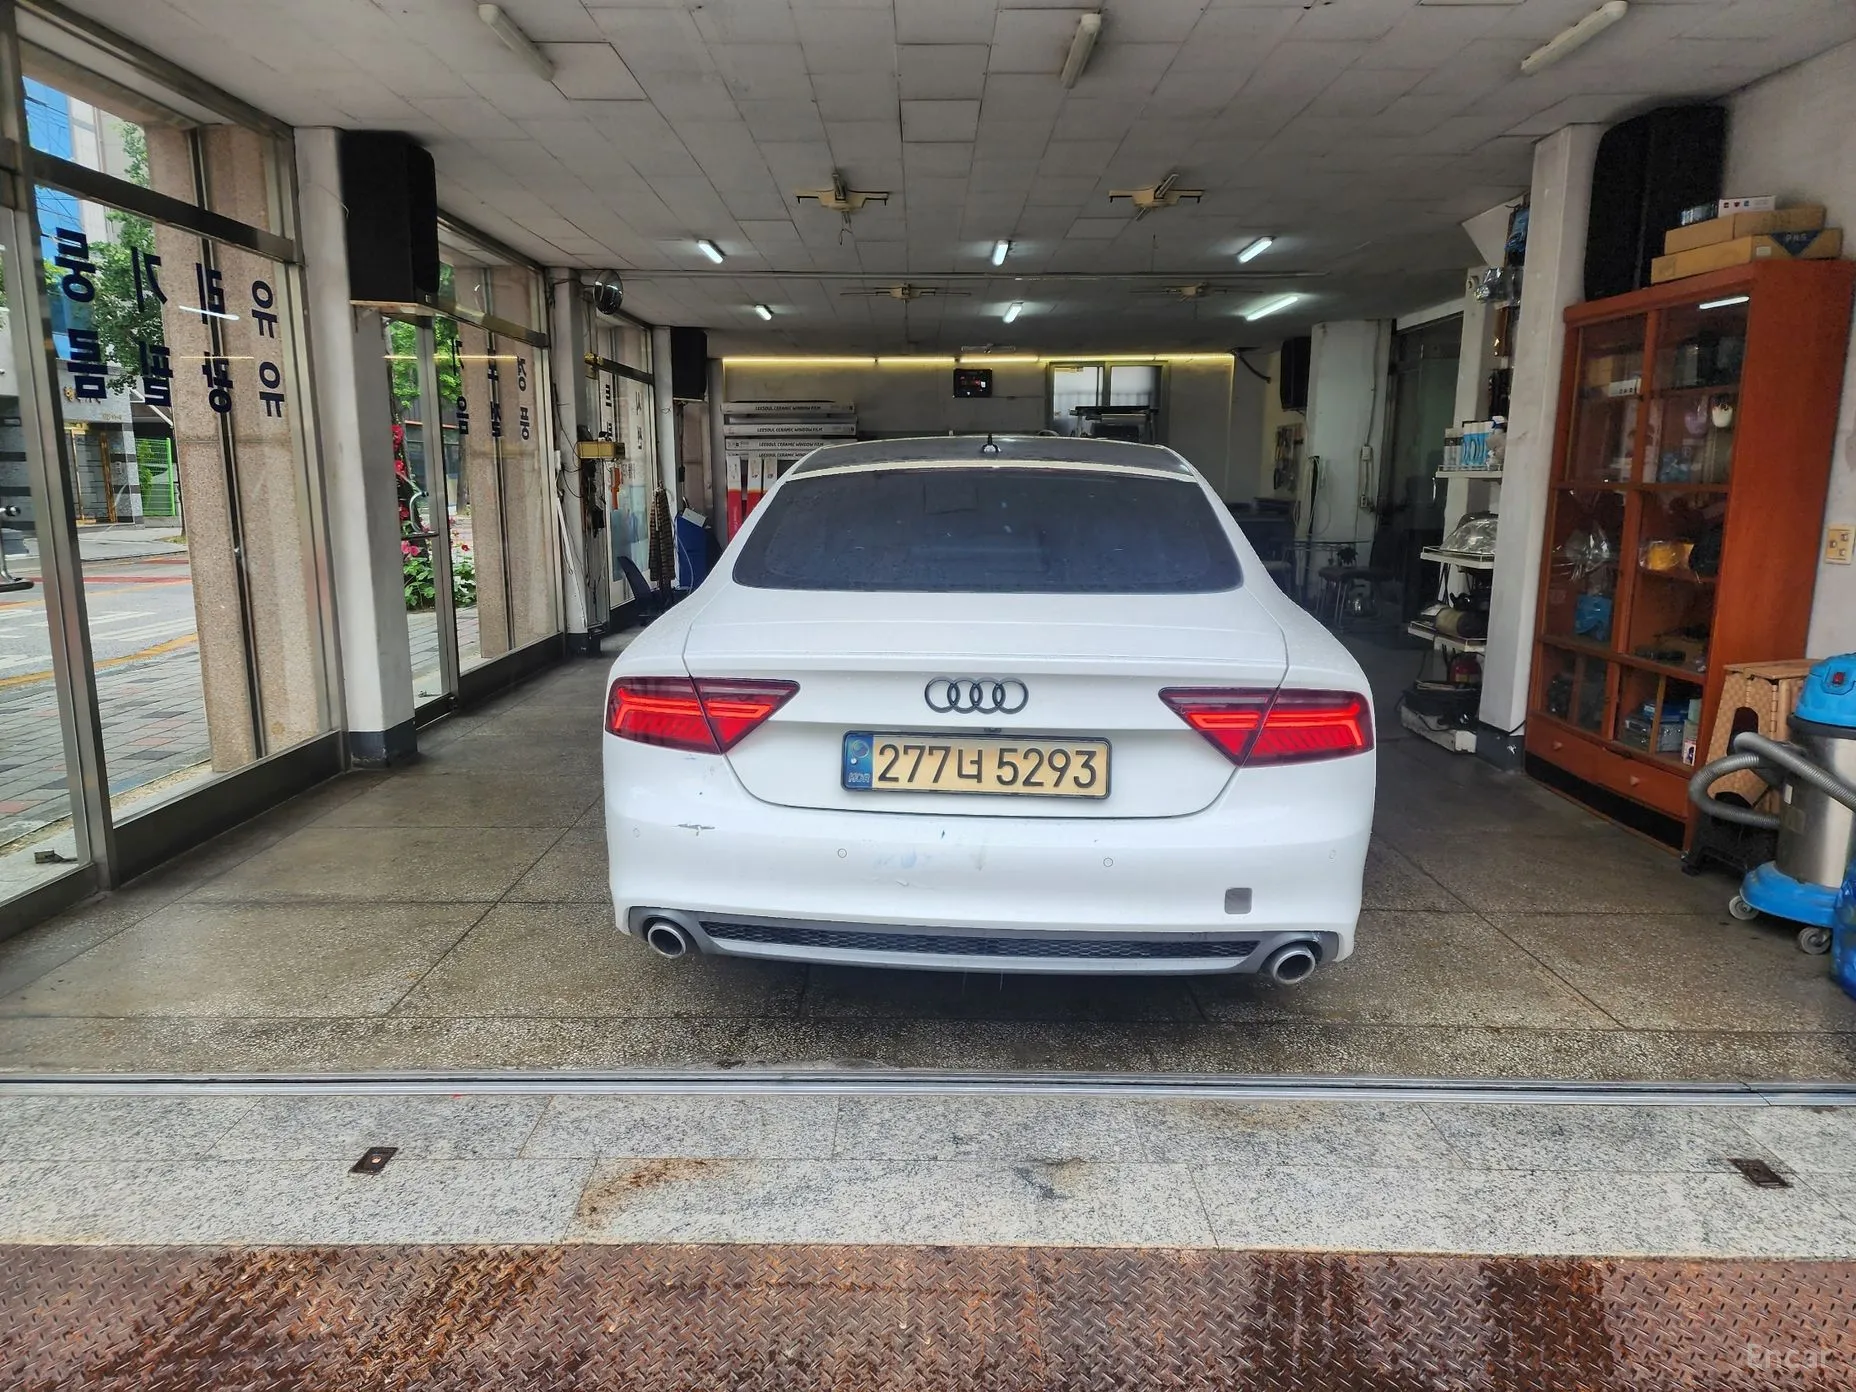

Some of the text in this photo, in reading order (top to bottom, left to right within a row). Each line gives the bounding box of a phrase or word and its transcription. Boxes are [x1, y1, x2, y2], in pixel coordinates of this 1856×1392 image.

[848, 771, 872, 783] KOR
[877, 743, 1098, 789] 277너 5293
